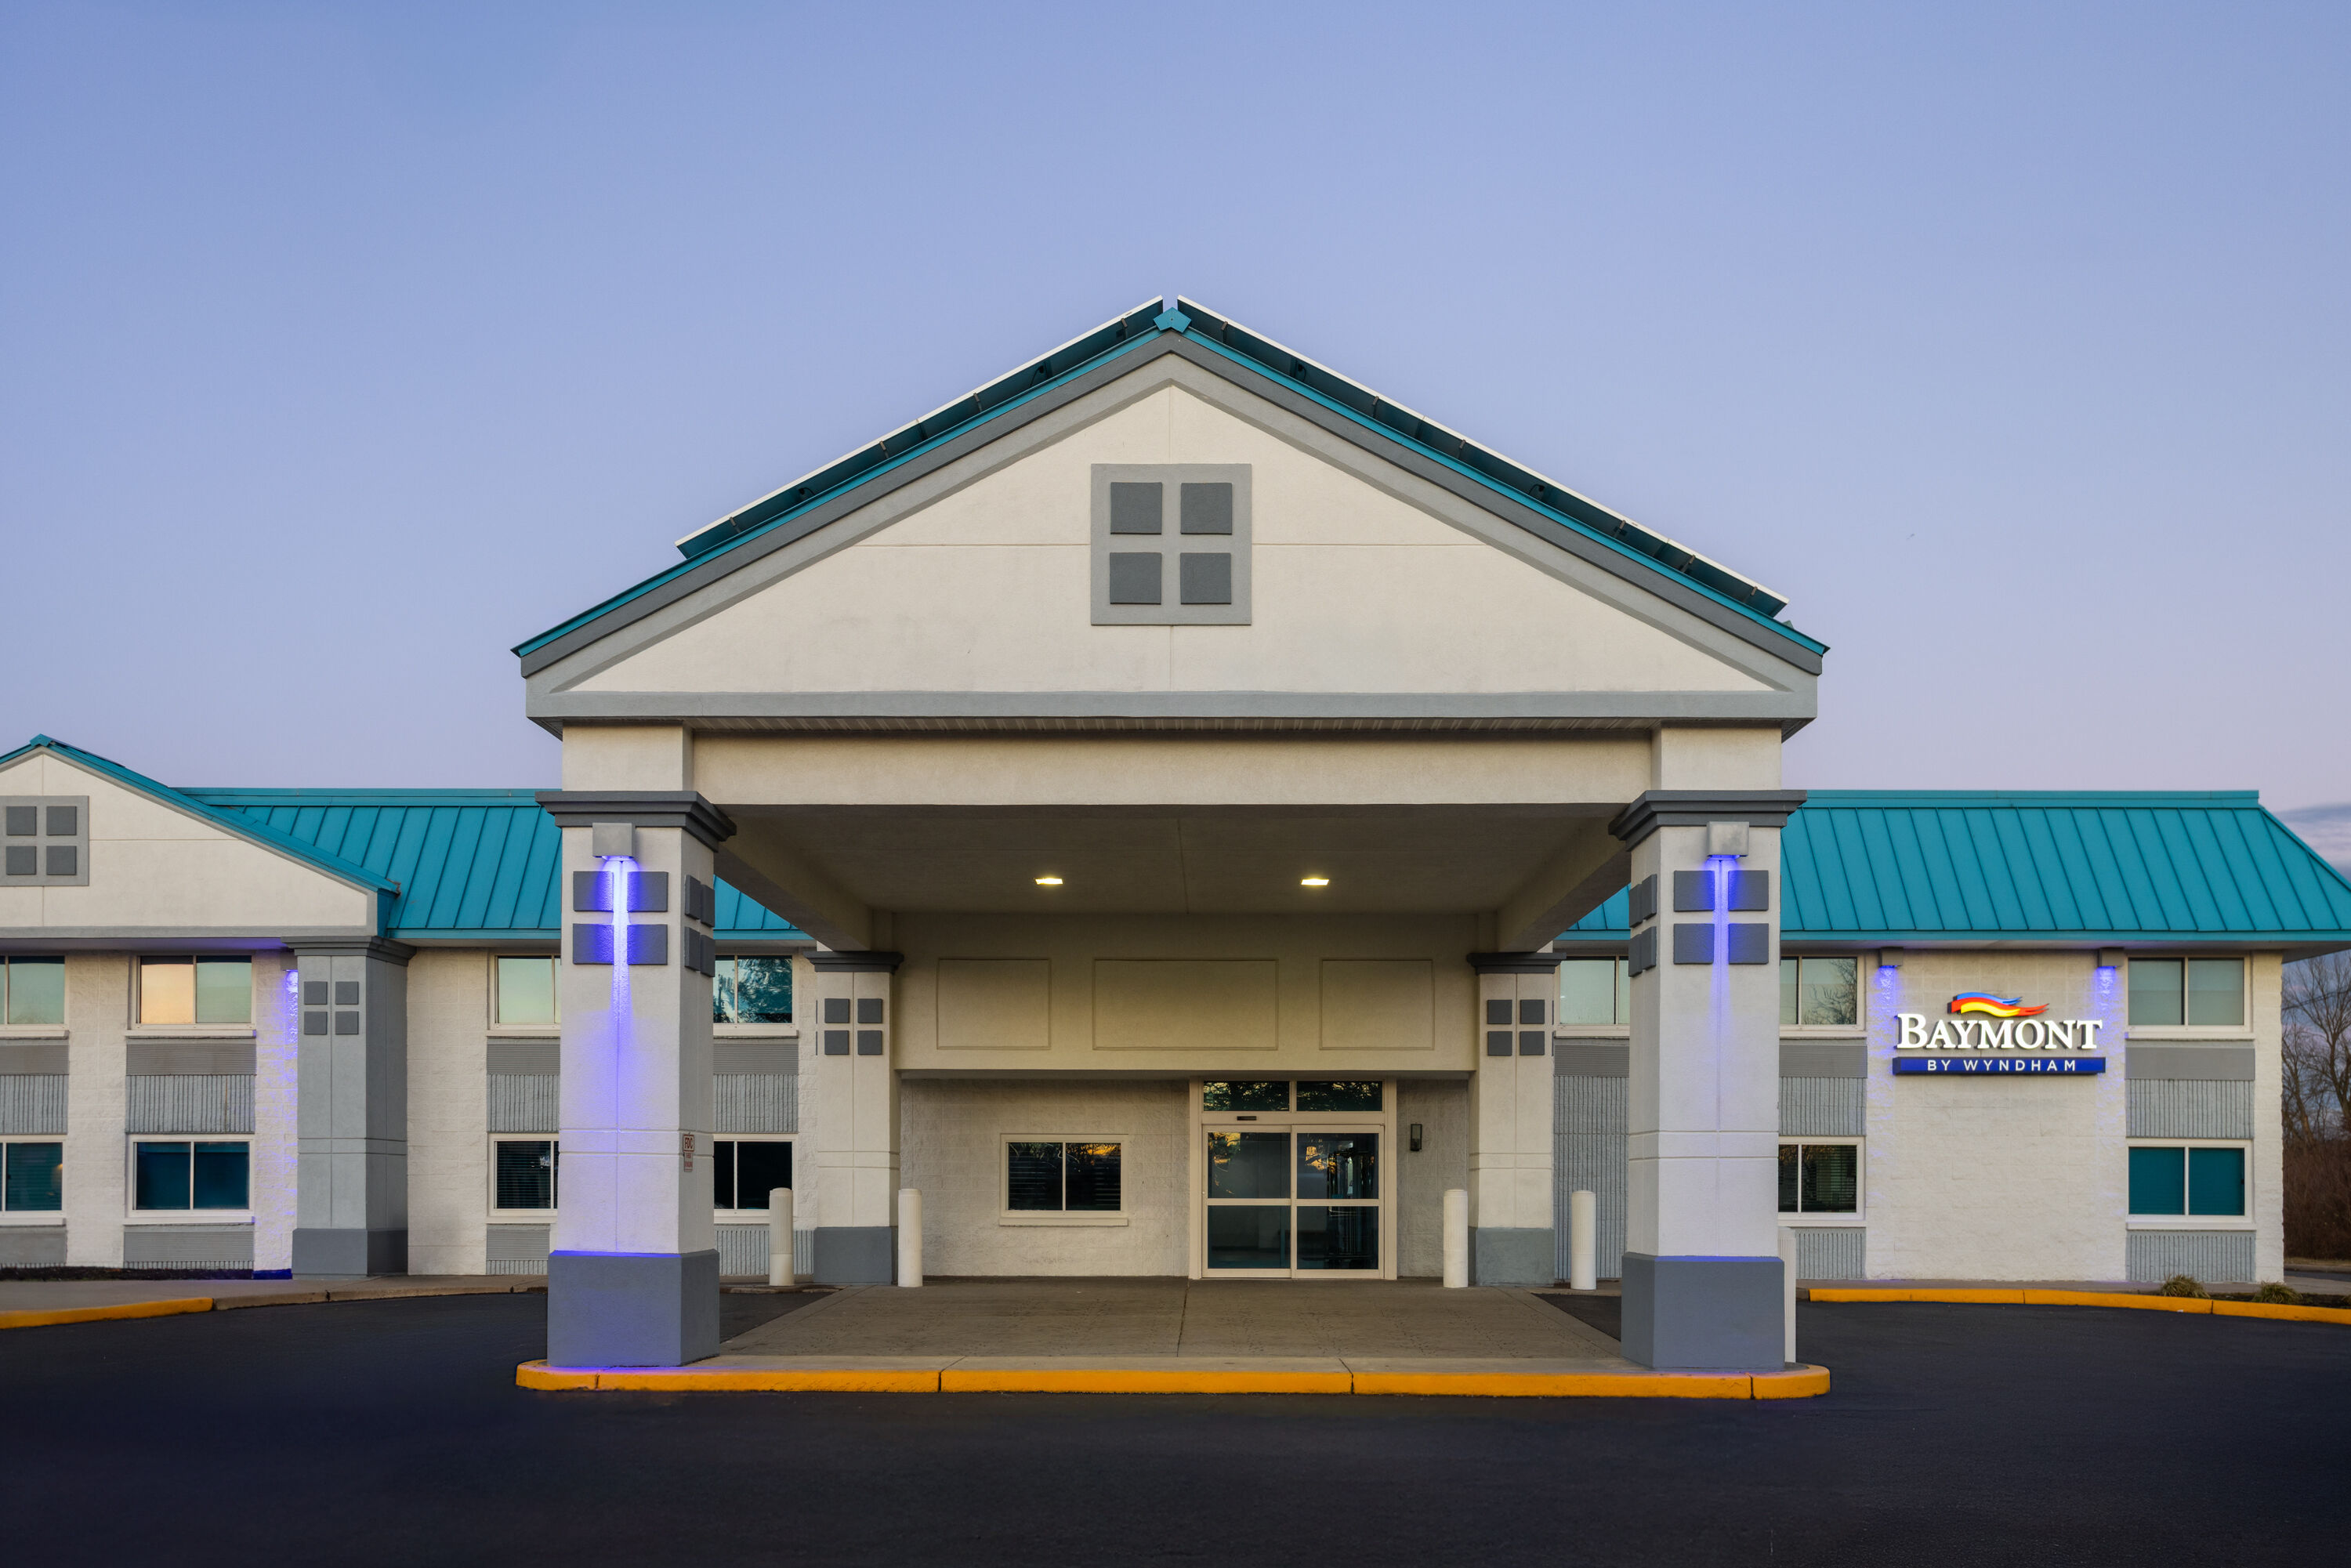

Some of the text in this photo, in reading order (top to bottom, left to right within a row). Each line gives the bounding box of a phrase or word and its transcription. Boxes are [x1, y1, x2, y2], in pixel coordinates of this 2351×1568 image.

[1896, 1013, 2103, 1049] BAYMONT
[1928, 1059, 2076, 1071] BY WYNDHAM
[684, 1137, 694, 1150] FDC
